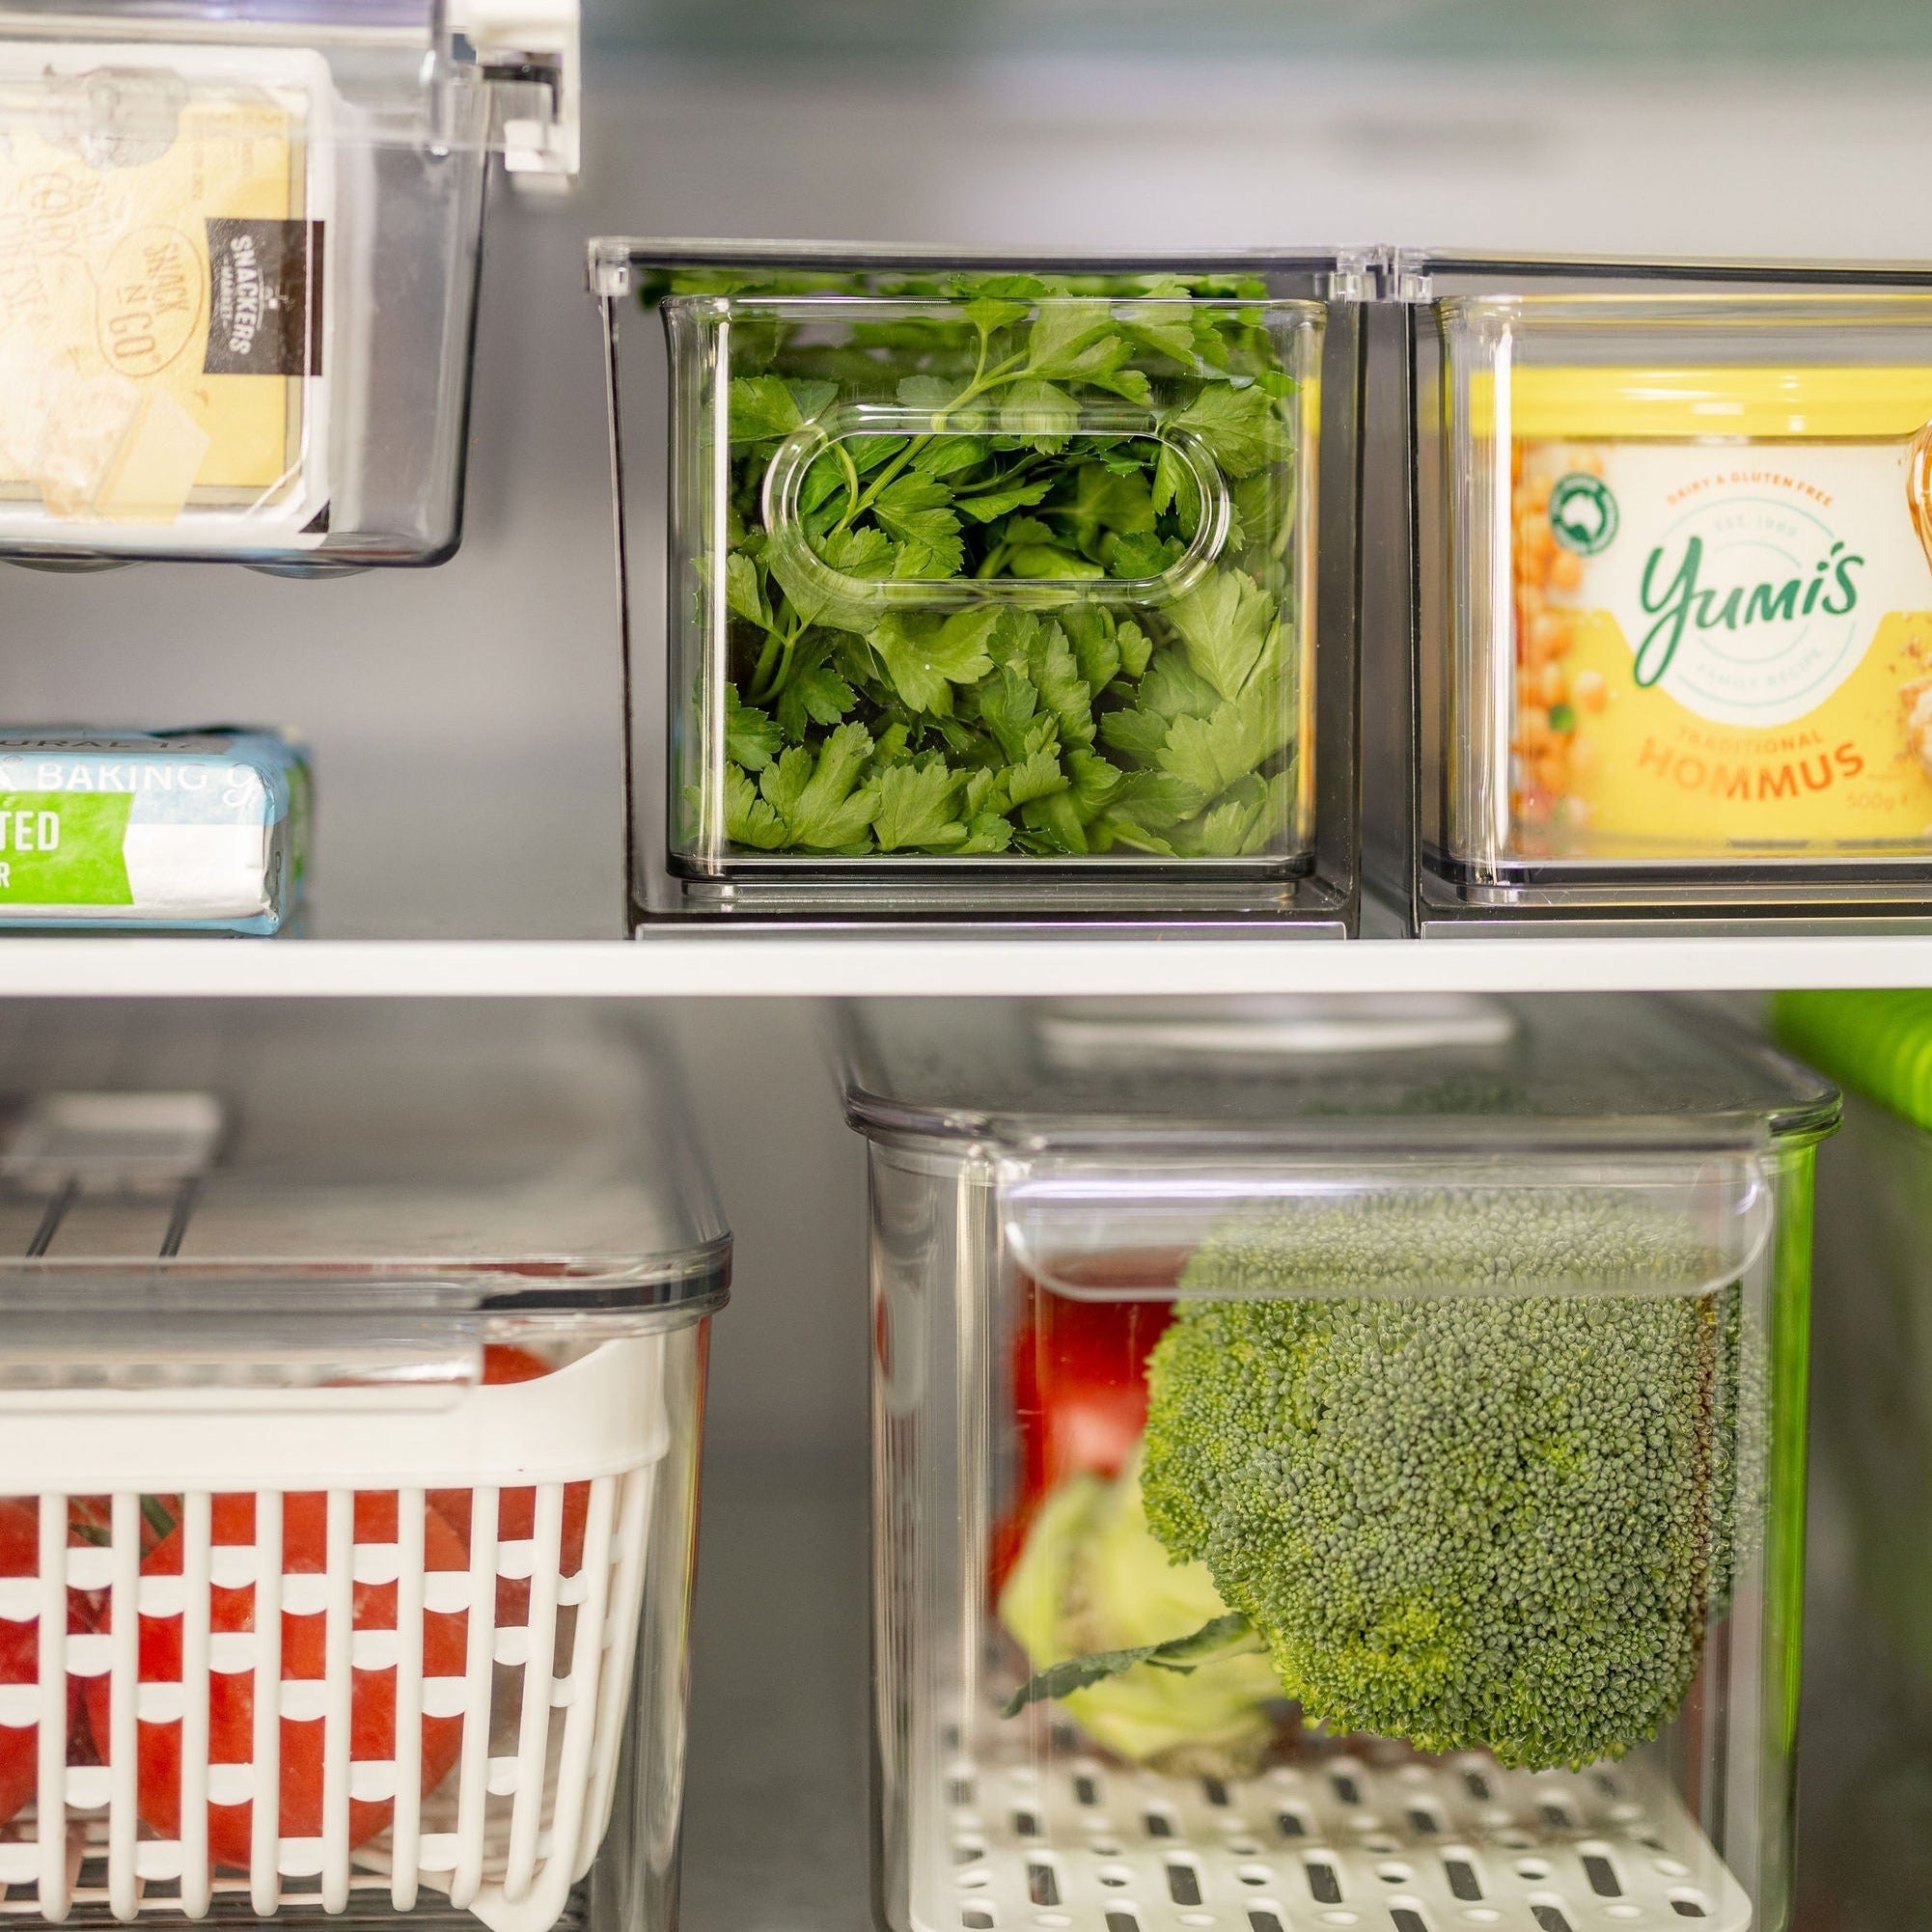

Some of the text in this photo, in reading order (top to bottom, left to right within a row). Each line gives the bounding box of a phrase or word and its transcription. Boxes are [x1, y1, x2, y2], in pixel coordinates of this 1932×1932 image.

[142, 241, 190, 315] SNACK
[229, 235, 260, 355] SNACKERS
[108, 312, 156, 360] GO
[1667, 477, 1710, 506] DAIRY
[1730, 472, 1793, 488] GLUTEN
[1796, 482, 1834, 507] FREE
[1675, 724, 1824, 755] TRADITIONAL
[37, 761, 208, 791] BAKING
[1638, 736, 1865, 802] HOMMUS
[0, 811, 60, 851] TED
